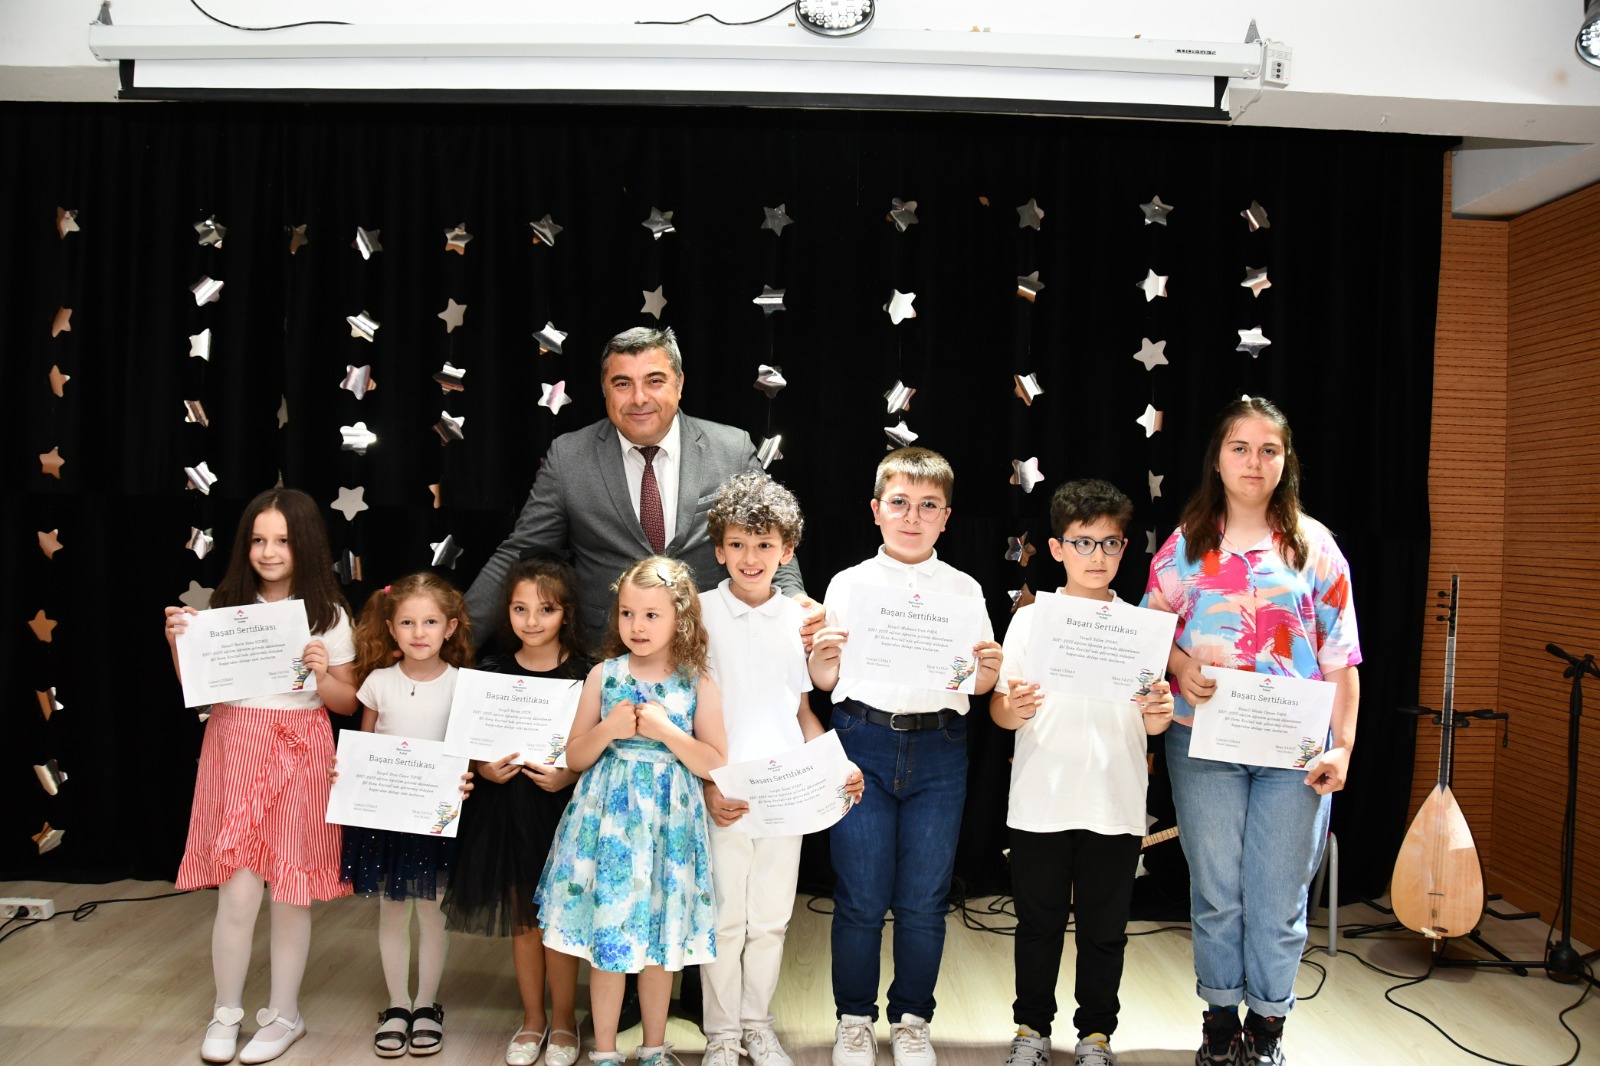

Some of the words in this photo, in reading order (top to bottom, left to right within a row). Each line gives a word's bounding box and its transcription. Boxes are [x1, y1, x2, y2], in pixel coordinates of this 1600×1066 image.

[880, 607, 906, 618] Başarı
[907, 611, 949, 623] Sertifikası
[210, 629, 235, 638] Başarı
[237, 624, 276, 634] Sertifikası
[1066, 617, 1093, 628] Başarı
[1094, 622, 1137, 635] Sertifikası
[1231, 690, 1256, 701] Başarı
[1257, 694, 1299, 706] Sertifikası
[369, 754, 393, 765] Başarı
[395, 757, 435, 770] Sertifikası
